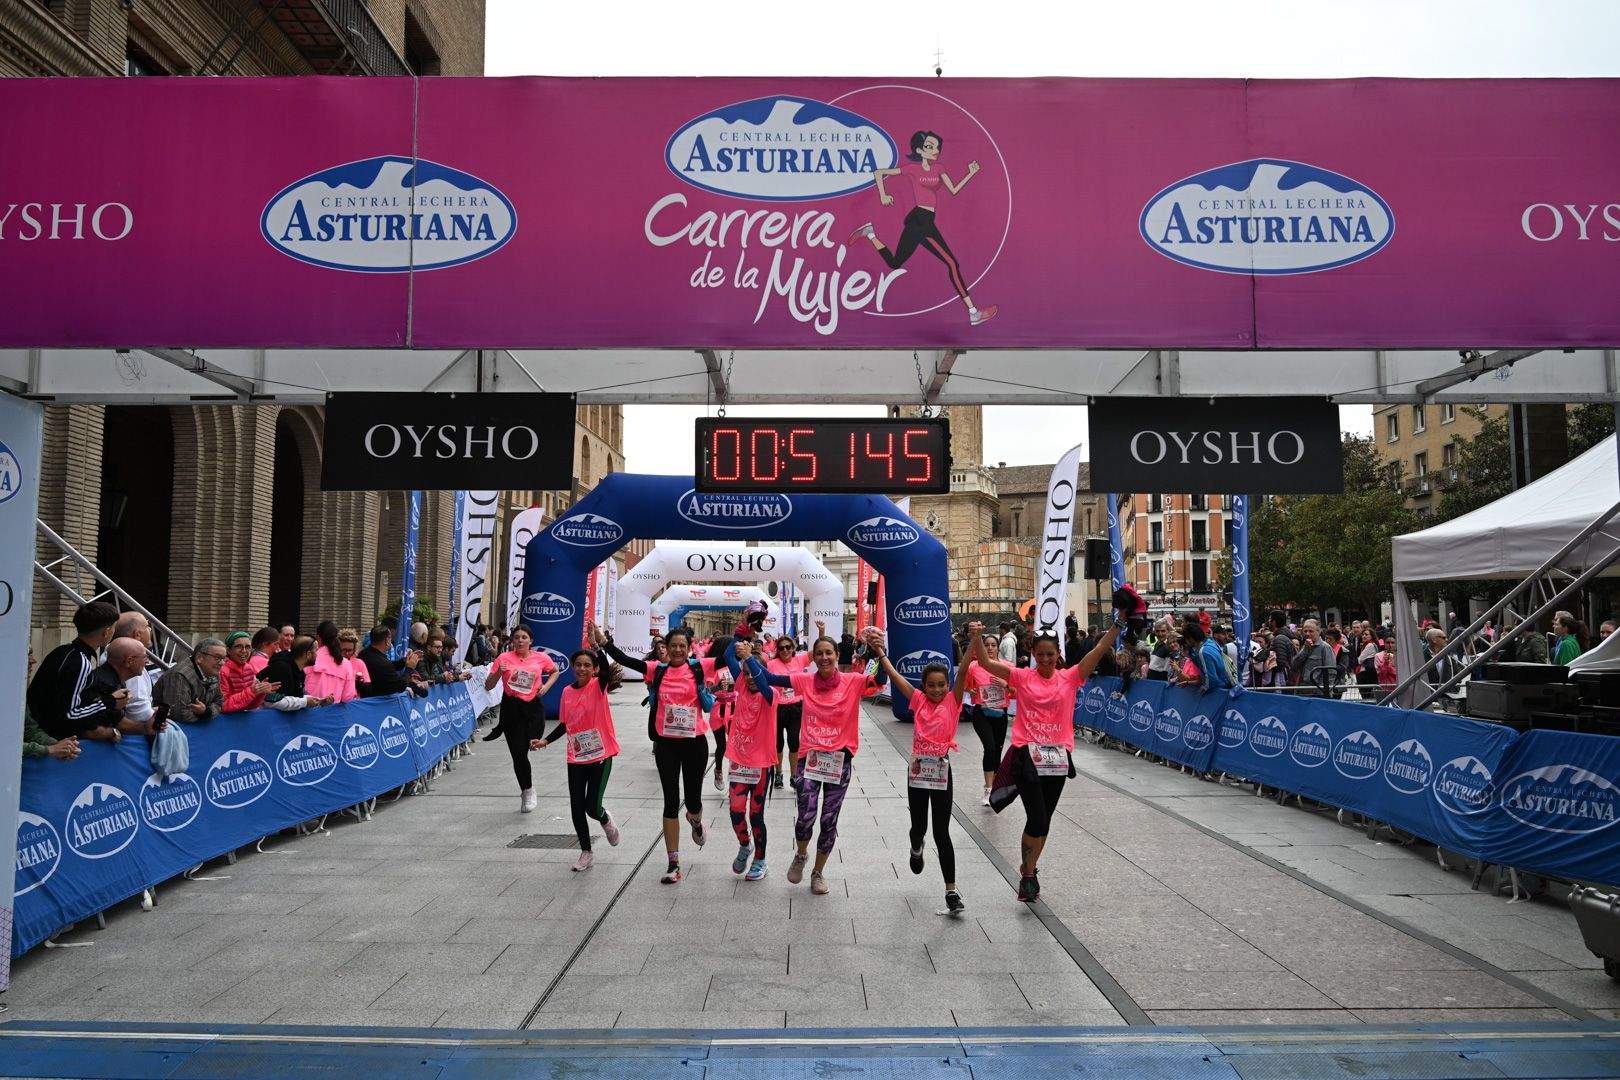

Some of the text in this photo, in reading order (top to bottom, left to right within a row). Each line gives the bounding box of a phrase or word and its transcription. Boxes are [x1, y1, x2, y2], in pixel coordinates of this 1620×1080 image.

[720, 133, 872, 143] CENTRAL LECHERA
[683, 134, 878, 174] ASTURIANA
[321, 196, 489, 207] CENTRAL LECHERA
[1198, 199, 1366, 210] CENTRAL LECHERA
[280, 200, 497, 243] ASTURIANA
[644, 192, 835, 248] Carrera
[1160, 202, 1376, 245] ASTURIANA
[690, 244, 907, 336] de la Mujer
[364, 423, 539, 461] OYSHO
[1130, 429, 1305, 466] OYSHO
[686, 496, 784, 517] ASTURIANA
[555, 524, 618, 539] ASTURIANA
[853, 529, 914, 541] ASTURIANA
[686, 553, 776, 572] OYSHO
[524, 602, 571, 615] ASTURIANA
[814, 609, 840, 617] OYSHO
[898, 608, 947, 619] ASTURIANA
[1251, 729, 1285, 749] ASTURIANA
[1292, 737, 1327, 759] ASTURIANA
[282, 753, 335, 778] ASTURIANA
[1335, 746, 1377, 770] ASTURIANA
[1386, 757, 1427, 785] ASTURIANA
[211, 770, 269, 800] ASTURIANA
[145, 791, 199, 820] ASTURIANA
[1508, 784, 1615, 822] ASTURIANA
[73, 809, 137, 849] ASTURIANA
